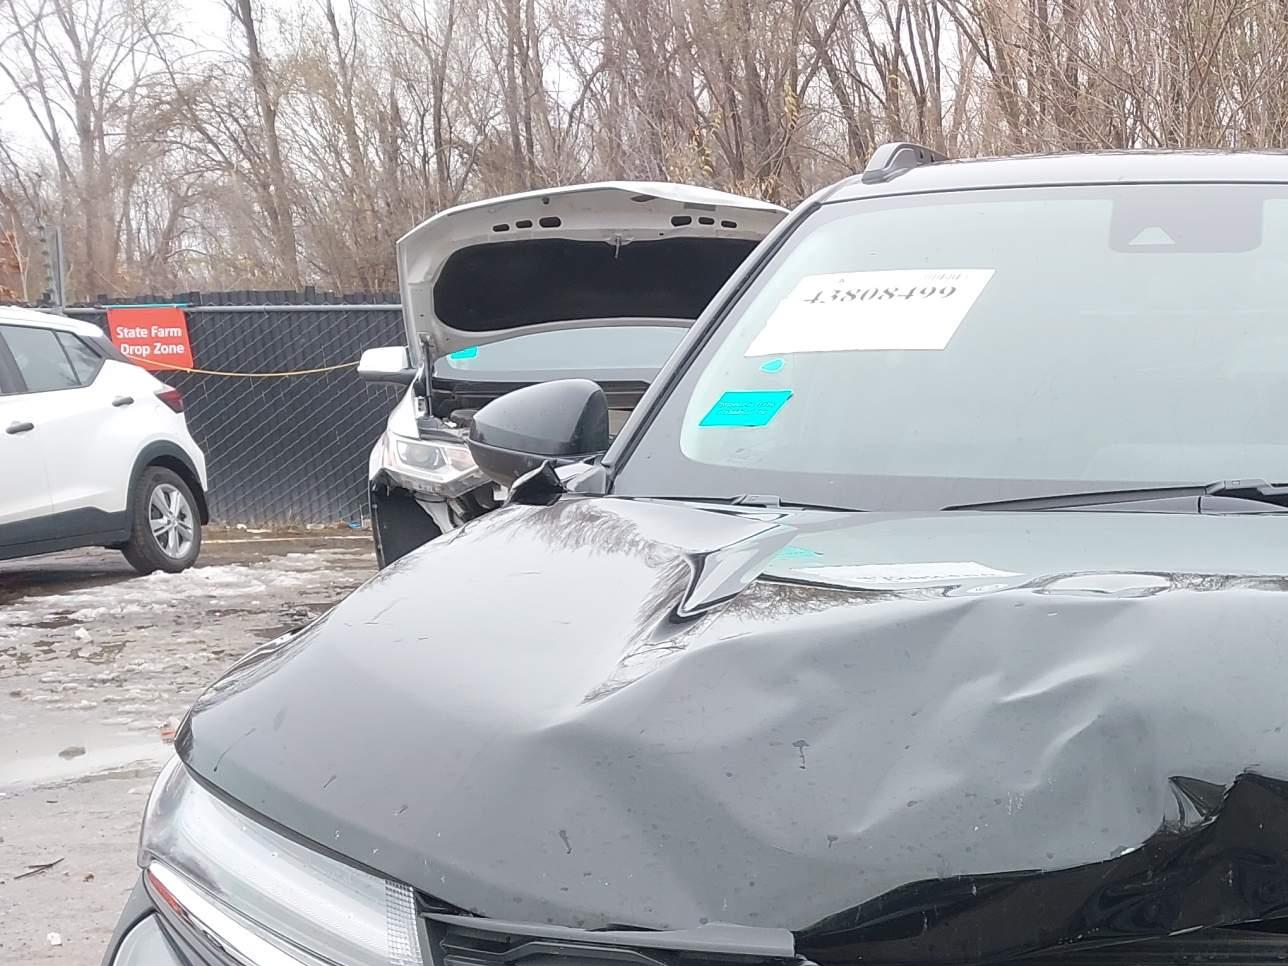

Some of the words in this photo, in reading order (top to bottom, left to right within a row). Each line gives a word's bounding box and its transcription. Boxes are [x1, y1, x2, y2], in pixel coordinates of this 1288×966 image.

[803, 286, 957, 304] 43808499
[116, 326, 148, 339] State
[151, 326, 182, 338] Farm
[120, 343, 150, 357] Drop
[153, 342, 185, 354] Zone
